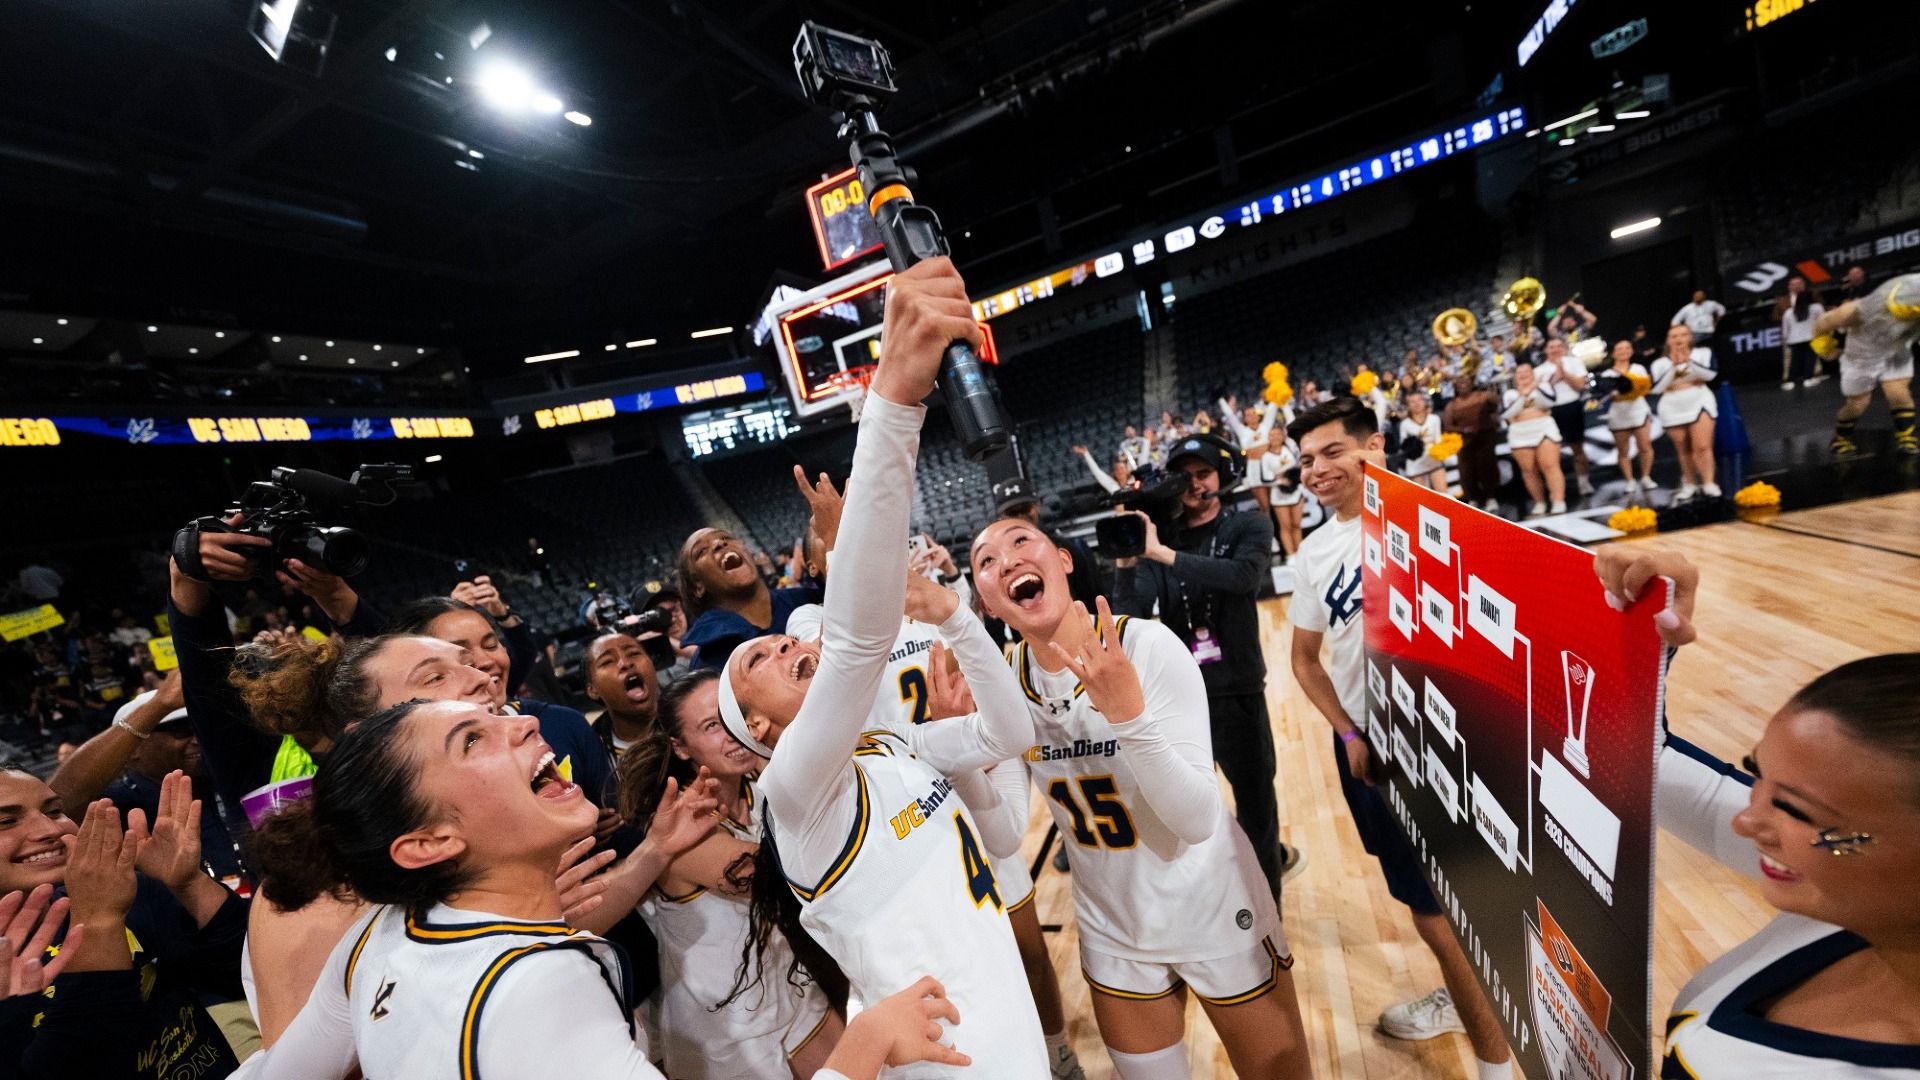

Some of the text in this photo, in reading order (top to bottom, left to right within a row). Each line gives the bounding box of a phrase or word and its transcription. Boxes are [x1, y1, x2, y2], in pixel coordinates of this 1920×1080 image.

[1015, 297, 1121, 343] SILVER
[1190, 216, 1349, 284] KNIGHTS
[1824, 229, 1920, 267] THE BIG
[1730, 327, 1783, 353] THE
[0, 417, 61, 446] IEGO
[187, 417, 312, 443] UC SAN DIEGO
[1047, 774, 1139, 851] 15
[952, 808, 1005, 917] 4
[1545, 814, 1613, 906] 2026 CHAMPIONS
[1389, 778, 1530, 1053] WOMEN'S CHAMPIONSHIP
[161, 1026, 180, 1055] San
[1545, 962, 1568, 1003] Credit
[1568, 997, 1594, 1042] Union
